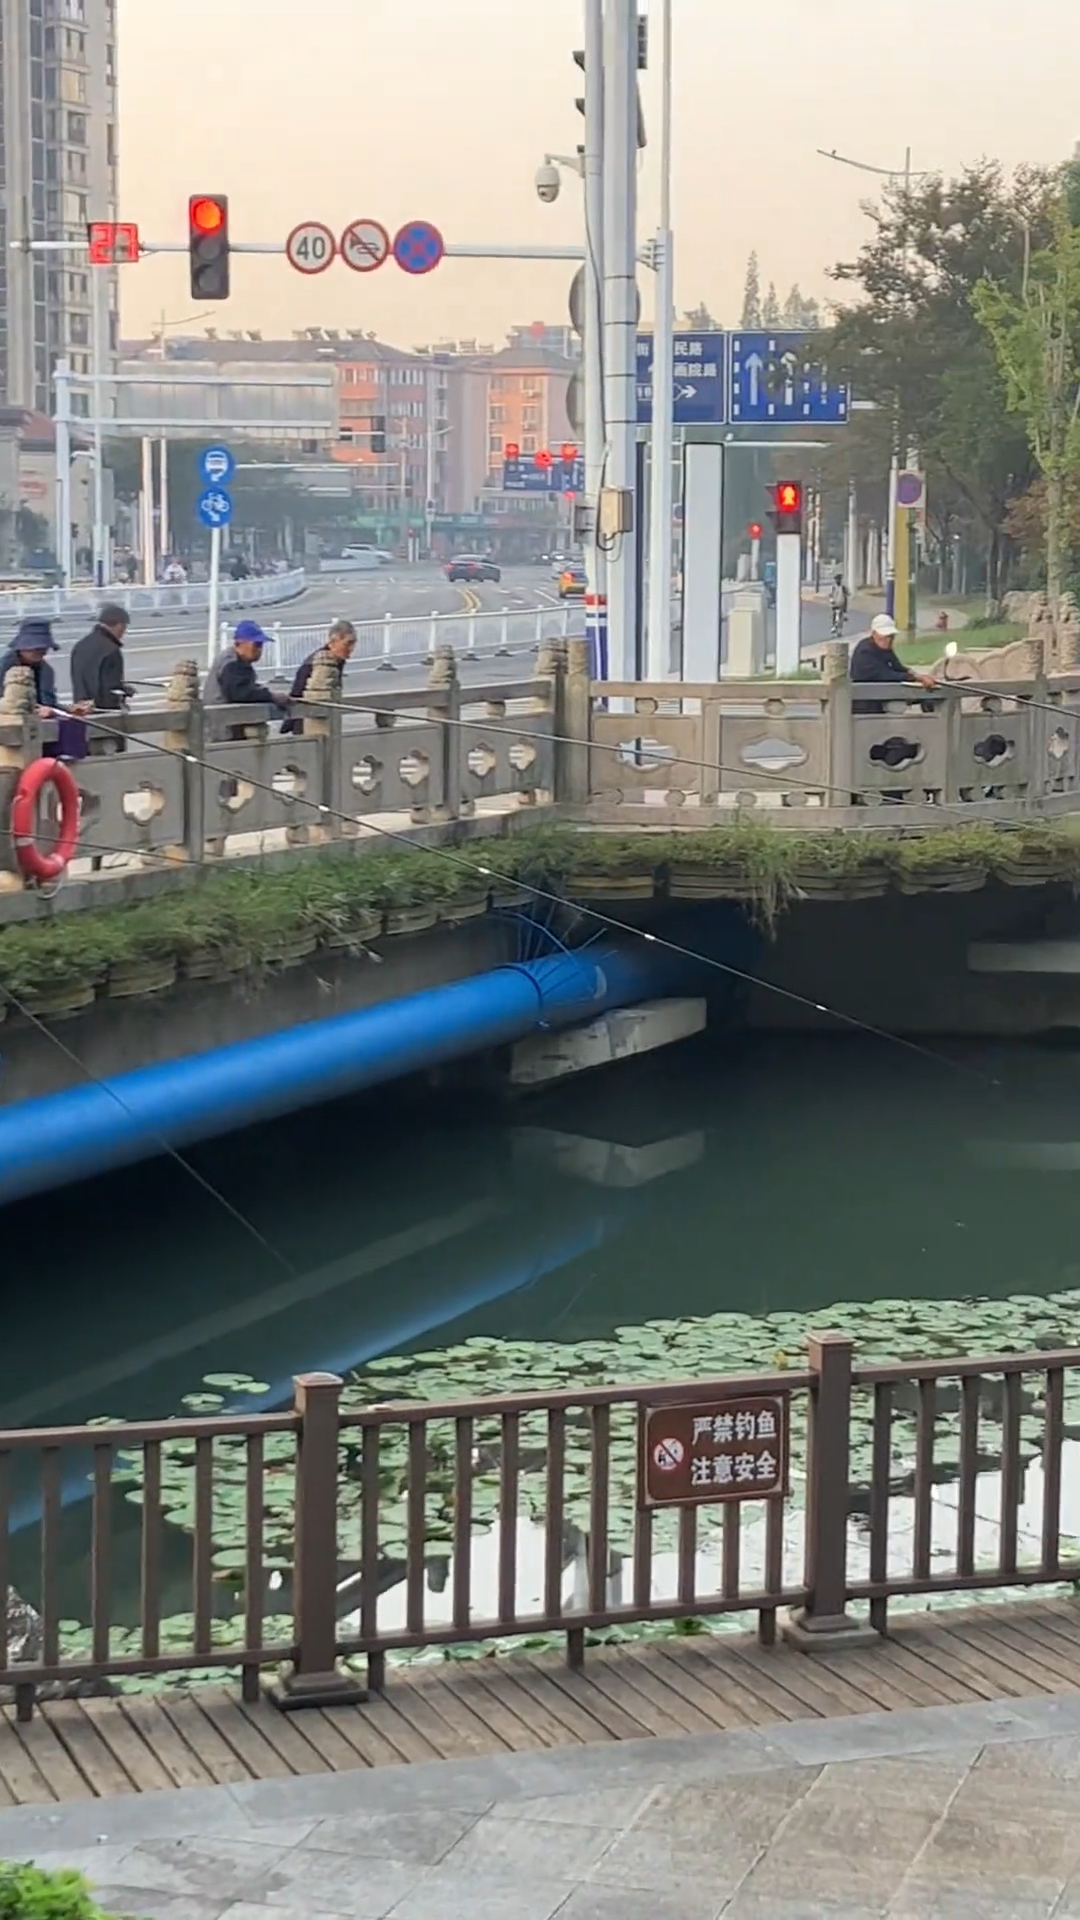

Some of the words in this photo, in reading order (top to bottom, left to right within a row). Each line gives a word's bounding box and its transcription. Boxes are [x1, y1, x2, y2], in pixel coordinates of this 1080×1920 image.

[90, 223, 138, 263] 27
[296, 236, 325, 260] 40
[692, 1410, 776, 1446] 严禁钓鱼
[691, 1450, 776, 1485] 注意安全
